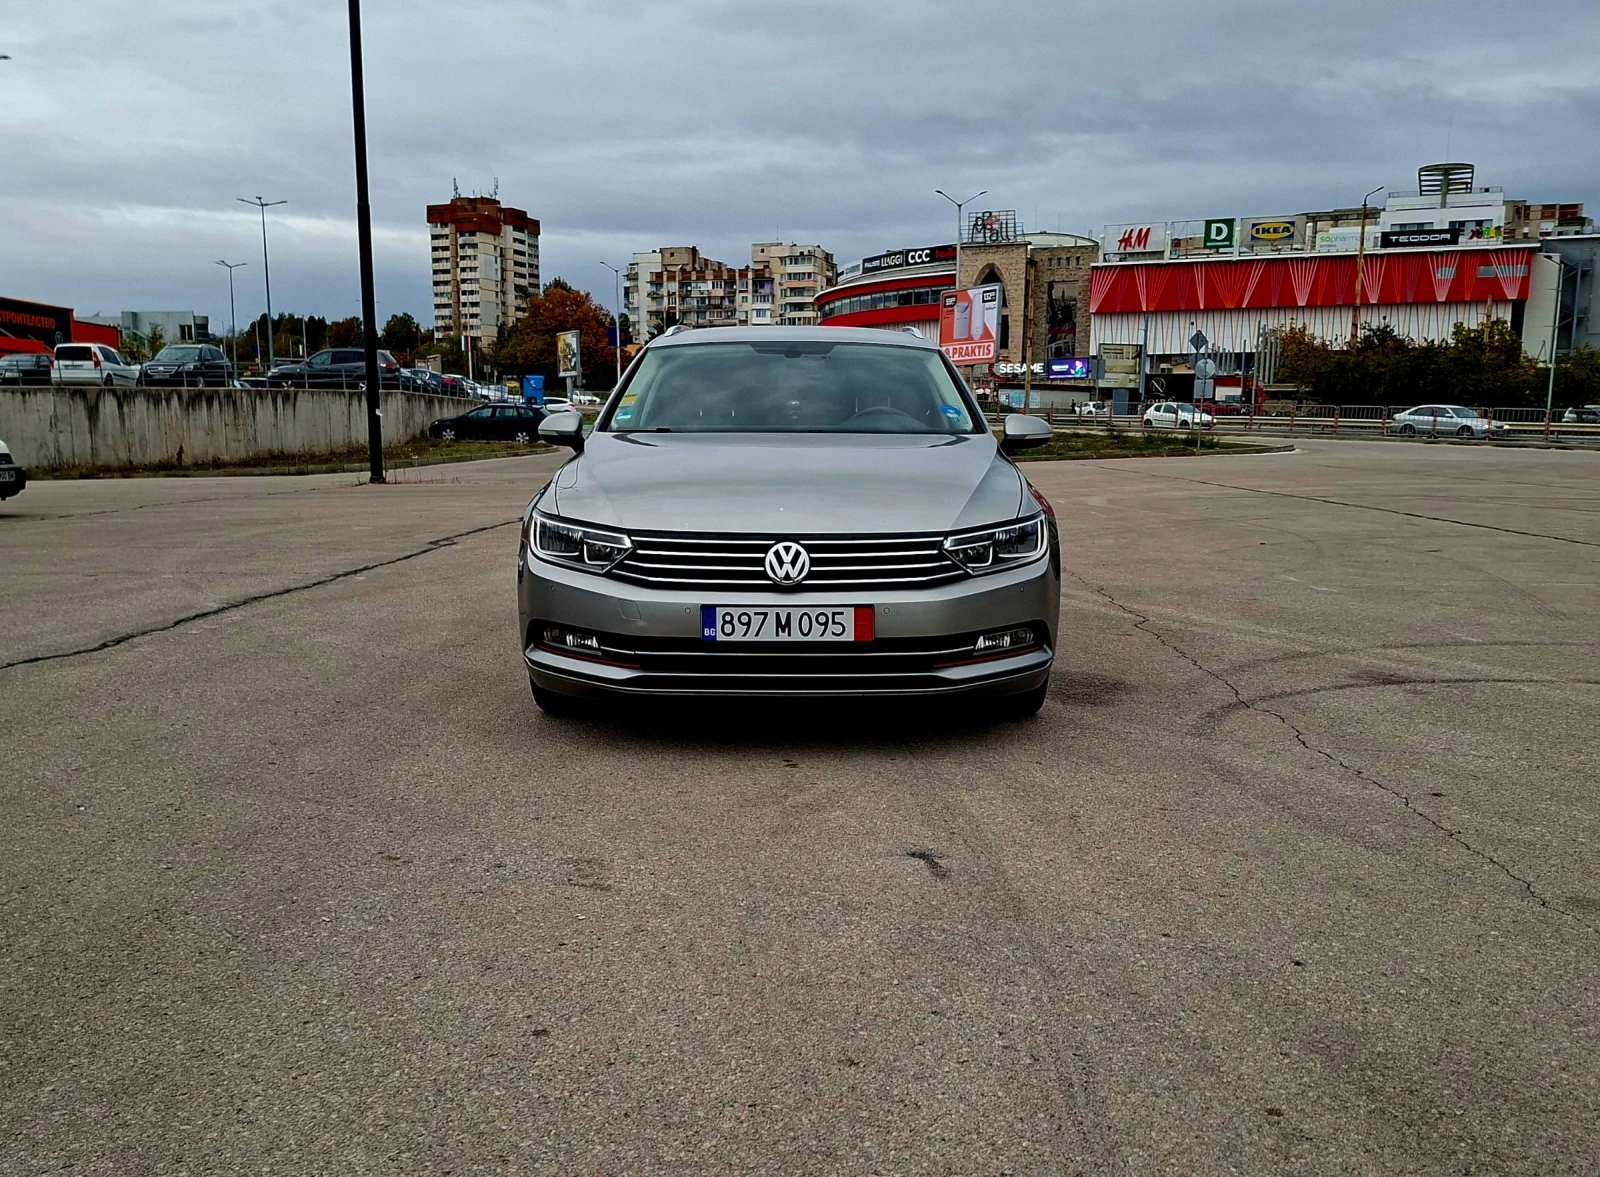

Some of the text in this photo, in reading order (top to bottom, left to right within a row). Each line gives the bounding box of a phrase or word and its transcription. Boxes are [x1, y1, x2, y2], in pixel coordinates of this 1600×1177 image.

[1210, 223, 1228, 240] D
[1255, 225, 1292, 235] IKEA
[1117, 226, 1152, 251] H&M
[1320, 235, 1370, 244] sopharmy
[1389, 233, 1451, 243] TEODOR
[908, 249, 931, 263] CCC
[952, 344, 992, 359] PRAKTIS
[999, 362, 1045, 374] SESAME
[720, 611, 846, 637] 897 M 095
[704, 628, 716, 636] BG
